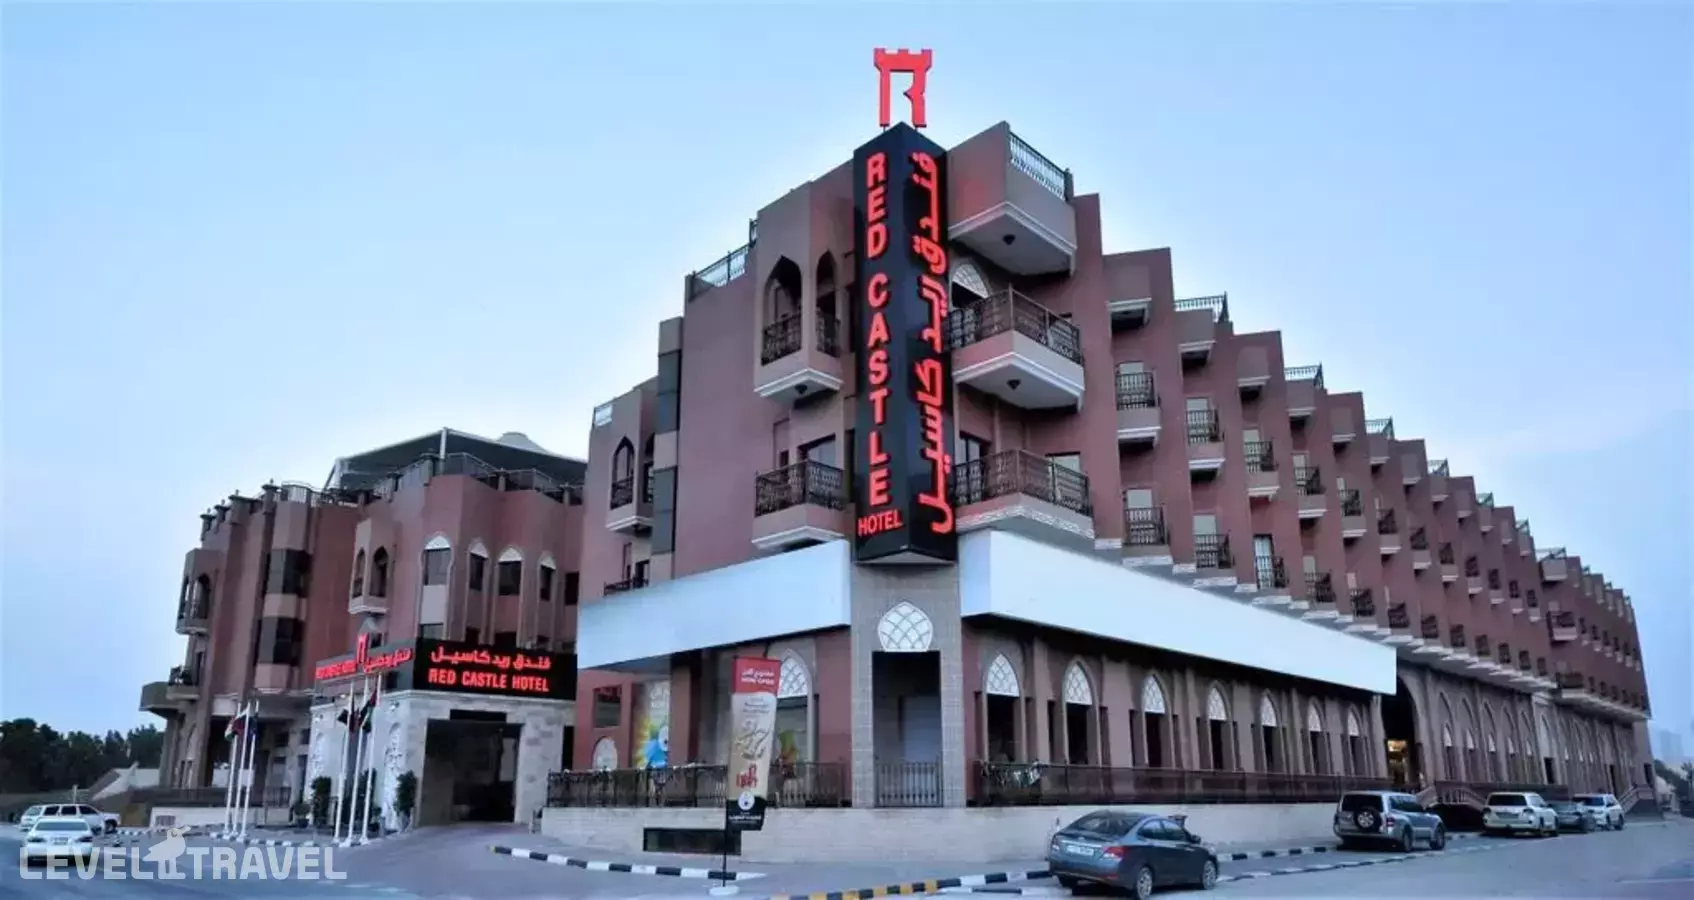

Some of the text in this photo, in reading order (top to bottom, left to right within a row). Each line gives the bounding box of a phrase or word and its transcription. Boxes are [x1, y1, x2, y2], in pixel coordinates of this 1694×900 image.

[866, 153, 890, 506] RED CASTLE
[912, 152, 954, 534] فندق ريد كاسيل
[858, 510, 903, 536] HOTEL
[431, 646, 490, 665] كاسيل
[492, 655, 510, 669] ريد
[513, 653, 551, 671] فندق
[428, 668, 549, 692] RED CASTLE HOTEL
